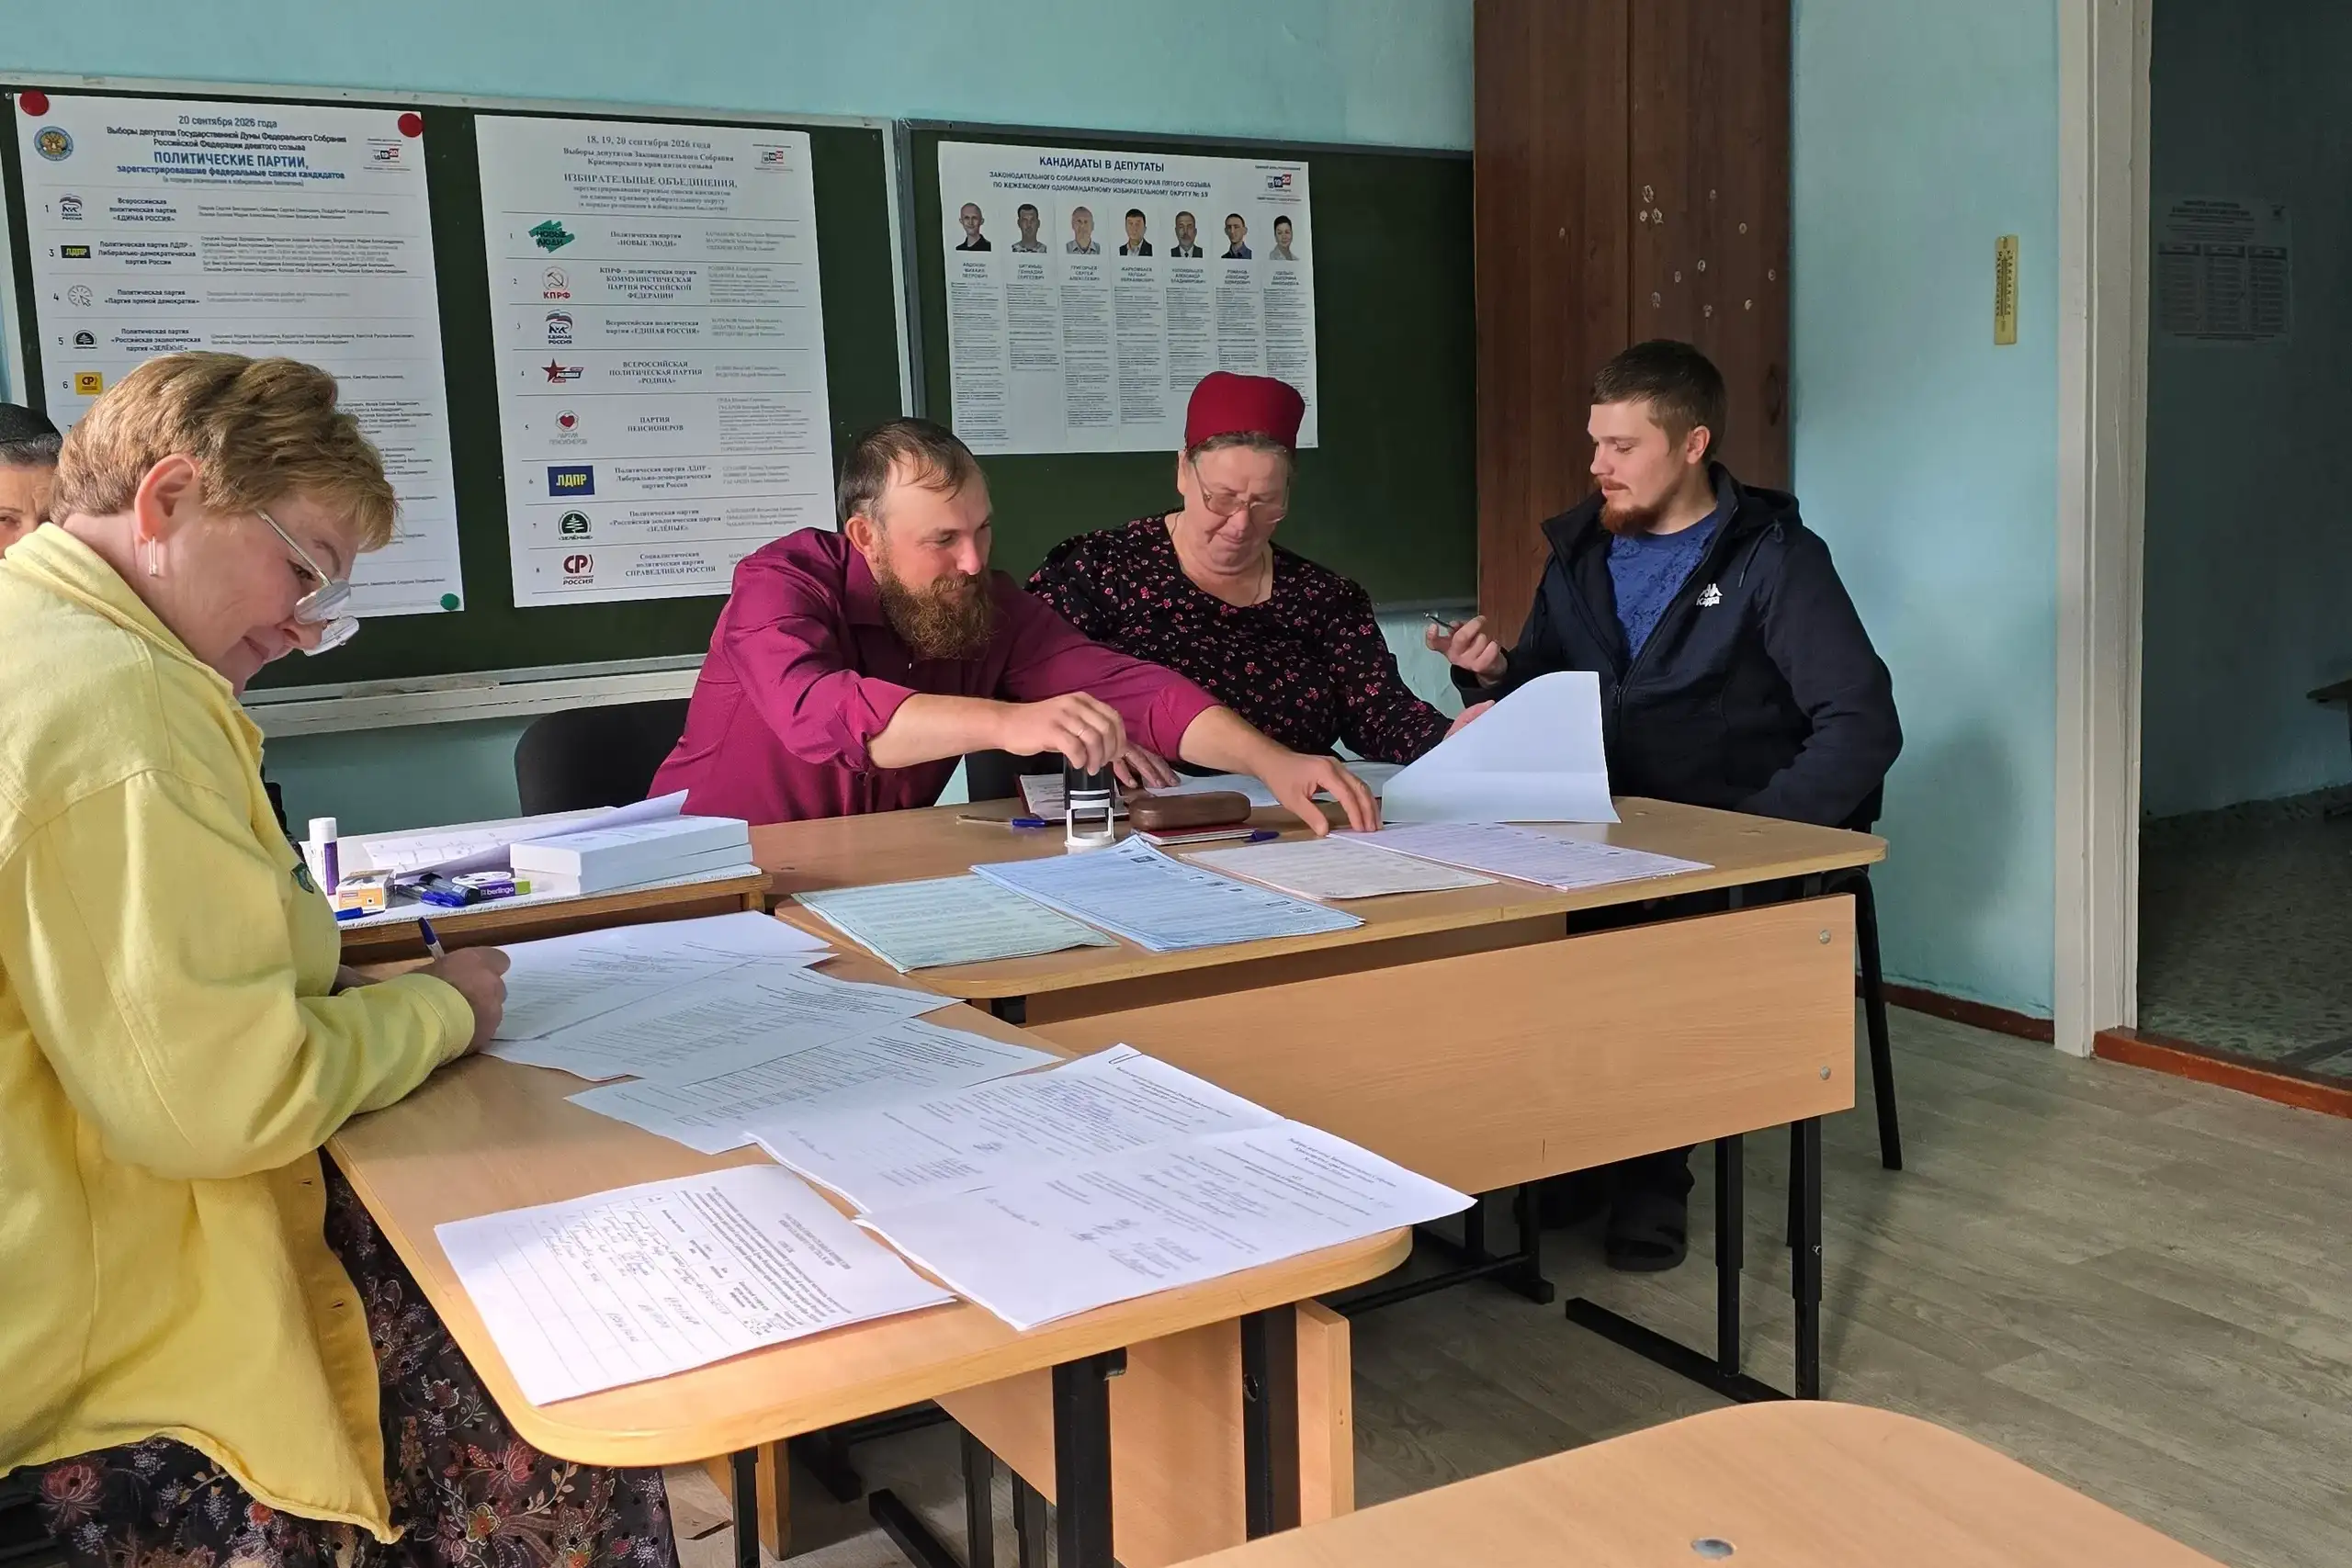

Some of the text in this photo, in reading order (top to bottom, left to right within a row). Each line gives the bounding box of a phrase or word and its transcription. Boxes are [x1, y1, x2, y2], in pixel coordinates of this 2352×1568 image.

[178, 115, 277, 129] 20 сентября 2026 года
[107, 126, 346, 143] Выборы депутатов Государственной Думы Федерального Собрания
[153, 139, 198, 148] Российской
[200, 140, 243, 150] Федерации
[244, 142, 277, 151] девятого
[616, 137, 626, 145] 20
[628, 138, 669, 147] сентября
[671, 140, 690, 148] 2026
[563, 147, 734, 162] Выборы депутатов Законодательного Собрания
[153, 152, 308, 170] ПОЛИТИЧЕСКИЕ ПАРТИИ,
[588, 158, 642, 167] Красноярского
[1039, 156, 1164, 173] КАНДИДАТЫ В ДЕПУТАТЫ
[117, 164, 207, 176] зарегистрировавшие
[209, 166, 266, 177] федеральные
[299, 171, 345, 180] кандидатов
[989, 172, 1055, 181] ЗАКОНОДАТЕЛЬНОГО
[1057, 175, 1091, 183] СОБРАНИЯ
[563, 173, 738, 188] ИЗБИРАТЕЛЬНЫЕ ОБЪЕДИНЕНИЯ,
[1004, 182, 1050, 191] КЕЖЕМСКОМУ
[1052, 185, 1112, 194] ОДНОМАНДАТНОМУ
[1113, 187, 1168, 196] ИЗБИРАТЕЛЬНОМУ
[610, 231, 657, 239] Политическая
[537, 238, 563, 246] ЛЮДИ
[49, 249, 54, 257] 3
[65, 247, 87, 256] ЛДПР
[53, 293, 59, 301] 4
[543, 291, 571, 299] КПРФ
[556, 474, 587, 487] ЛДПР
[616, 474, 711, 482] Либерально-демократическая
[699, 515, 721, 524] партия
[625, 568, 685, 577] СПРАВЕДЛИВАЯ
[487, 886, 514, 896] berlingo
